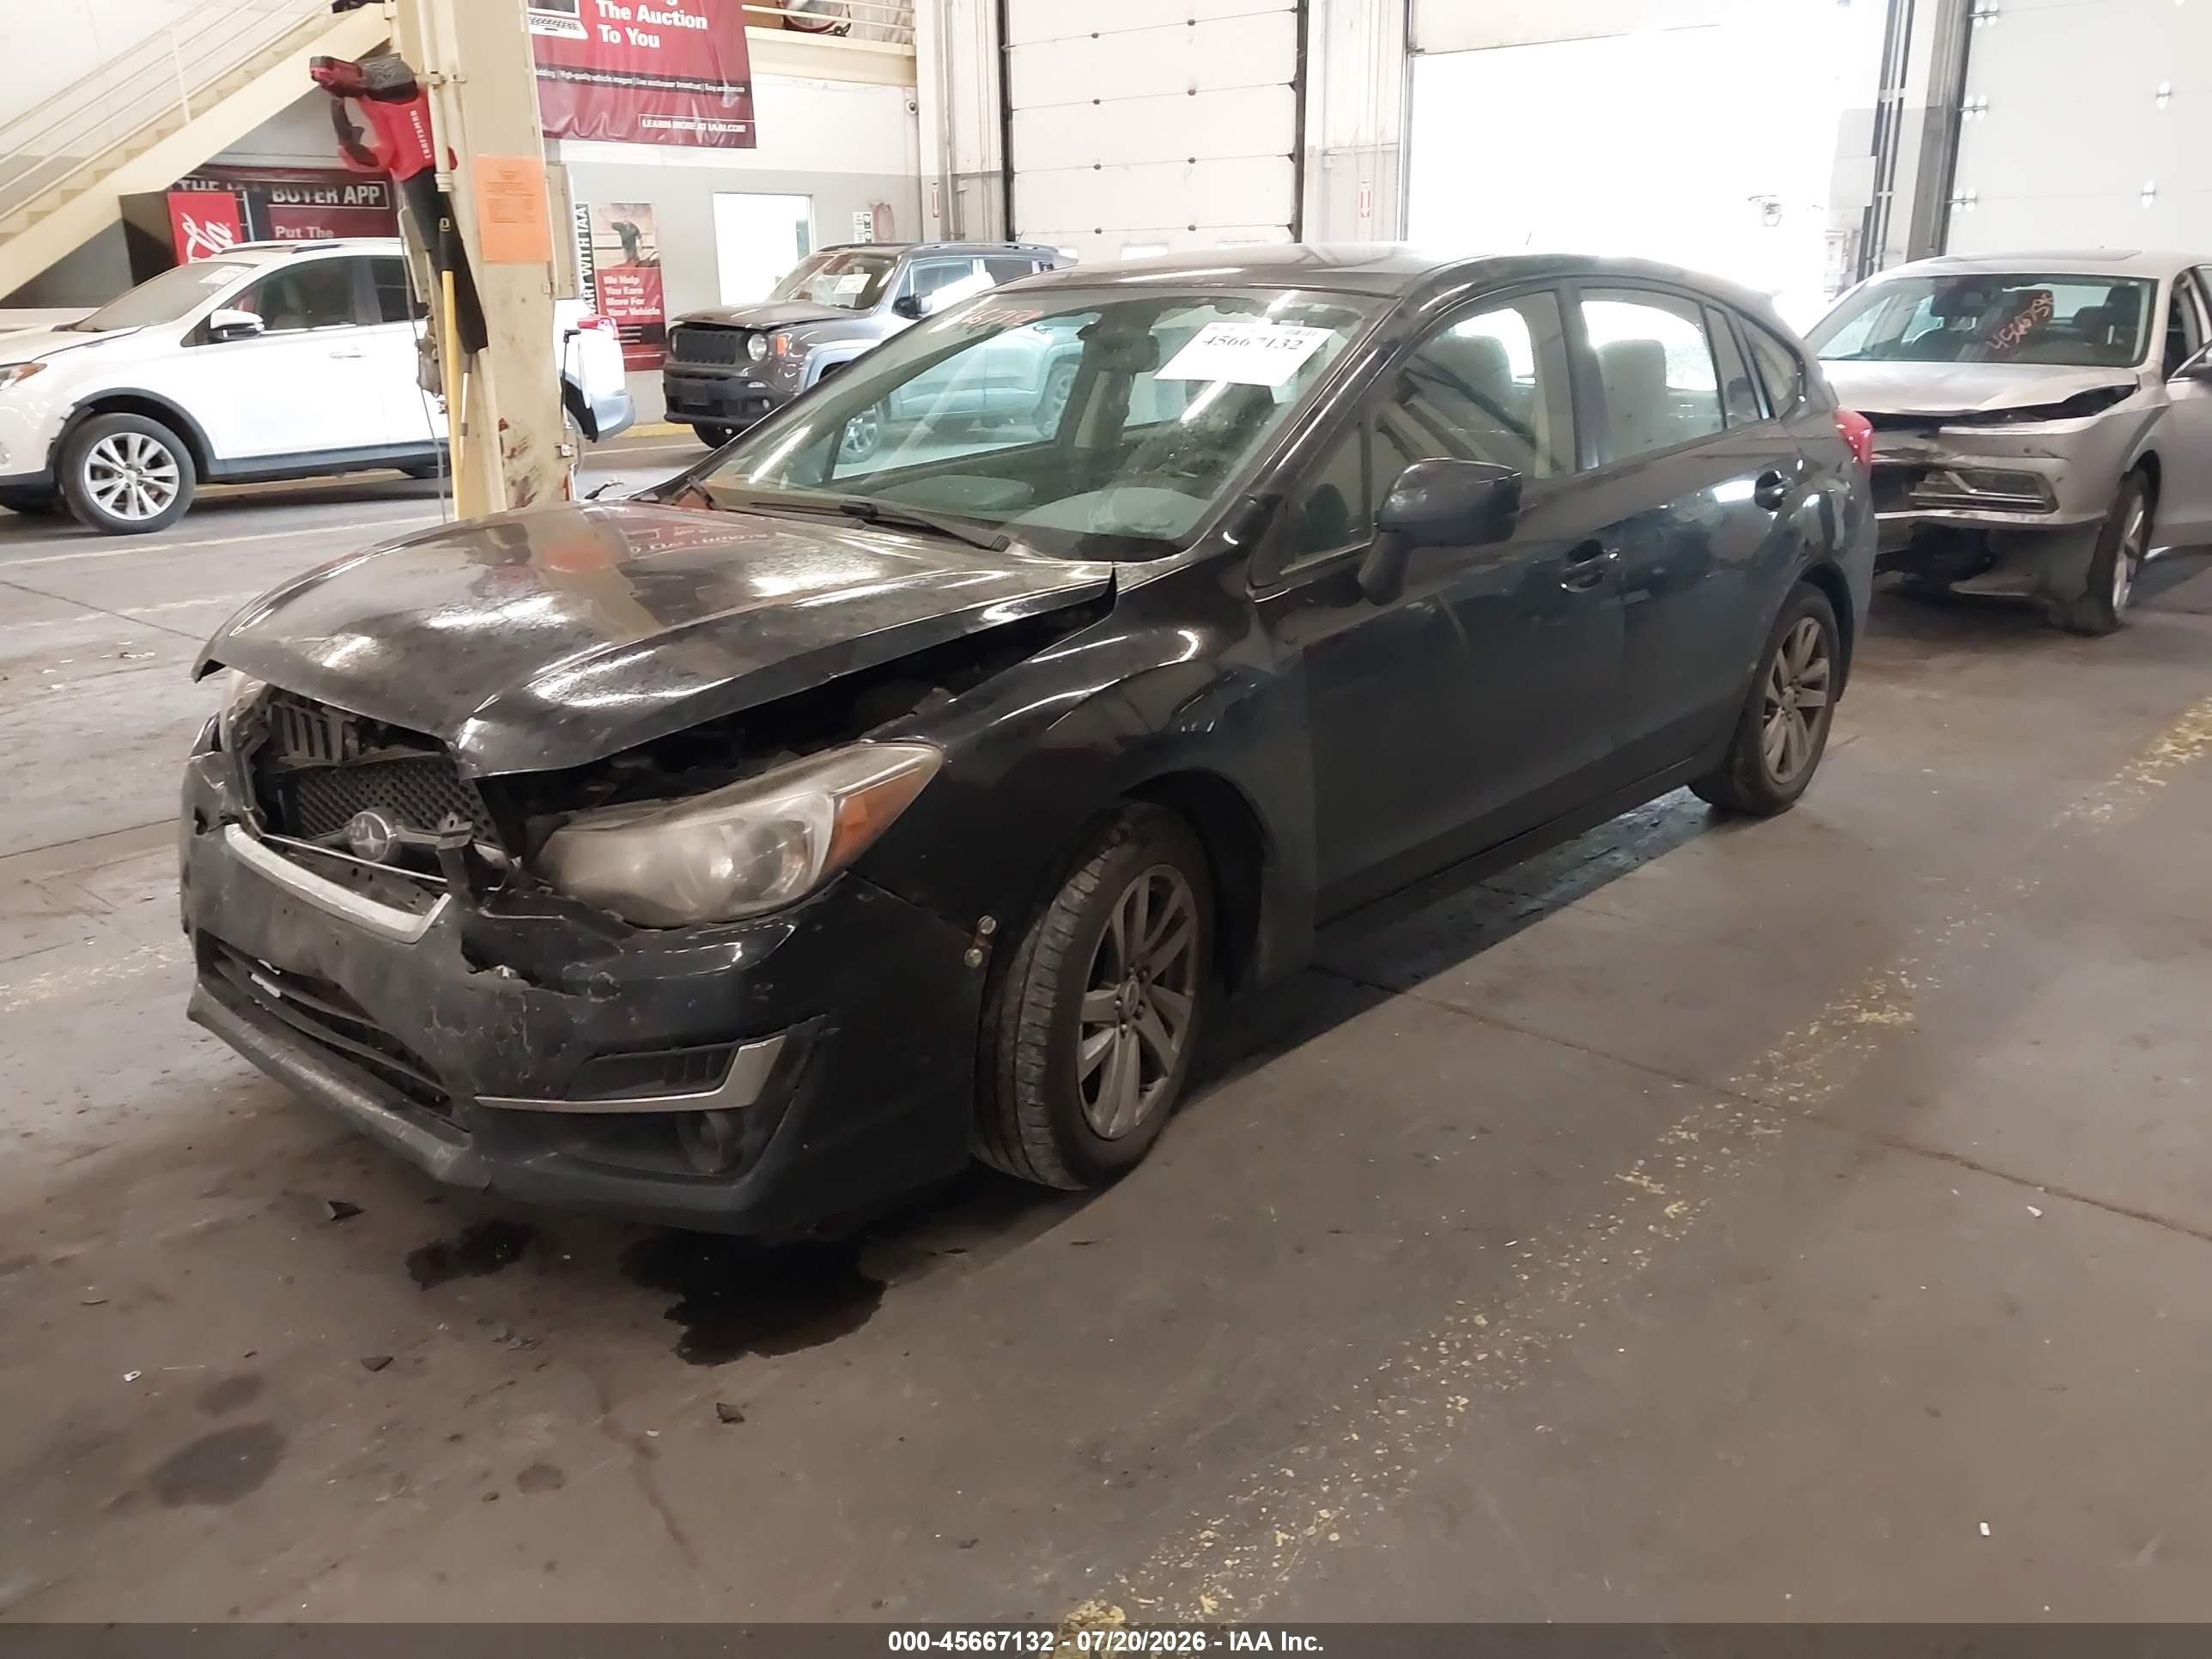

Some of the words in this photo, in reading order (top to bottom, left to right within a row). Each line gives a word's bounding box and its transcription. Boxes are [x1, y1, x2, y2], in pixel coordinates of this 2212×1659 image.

[595, 0, 633, 21] The
[636, 4, 708, 30] Auction
[597, 24, 623, 44] To
[624, 27, 660, 48] You
[343, 185, 381, 204] APP
[275, 226, 301, 239] Put
[308, 226, 334, 239] The
[575, 207, 589, 234] IAA
[578, 237, 592, 276] WITH
[1202, 334, 1304, 350] 45667132
